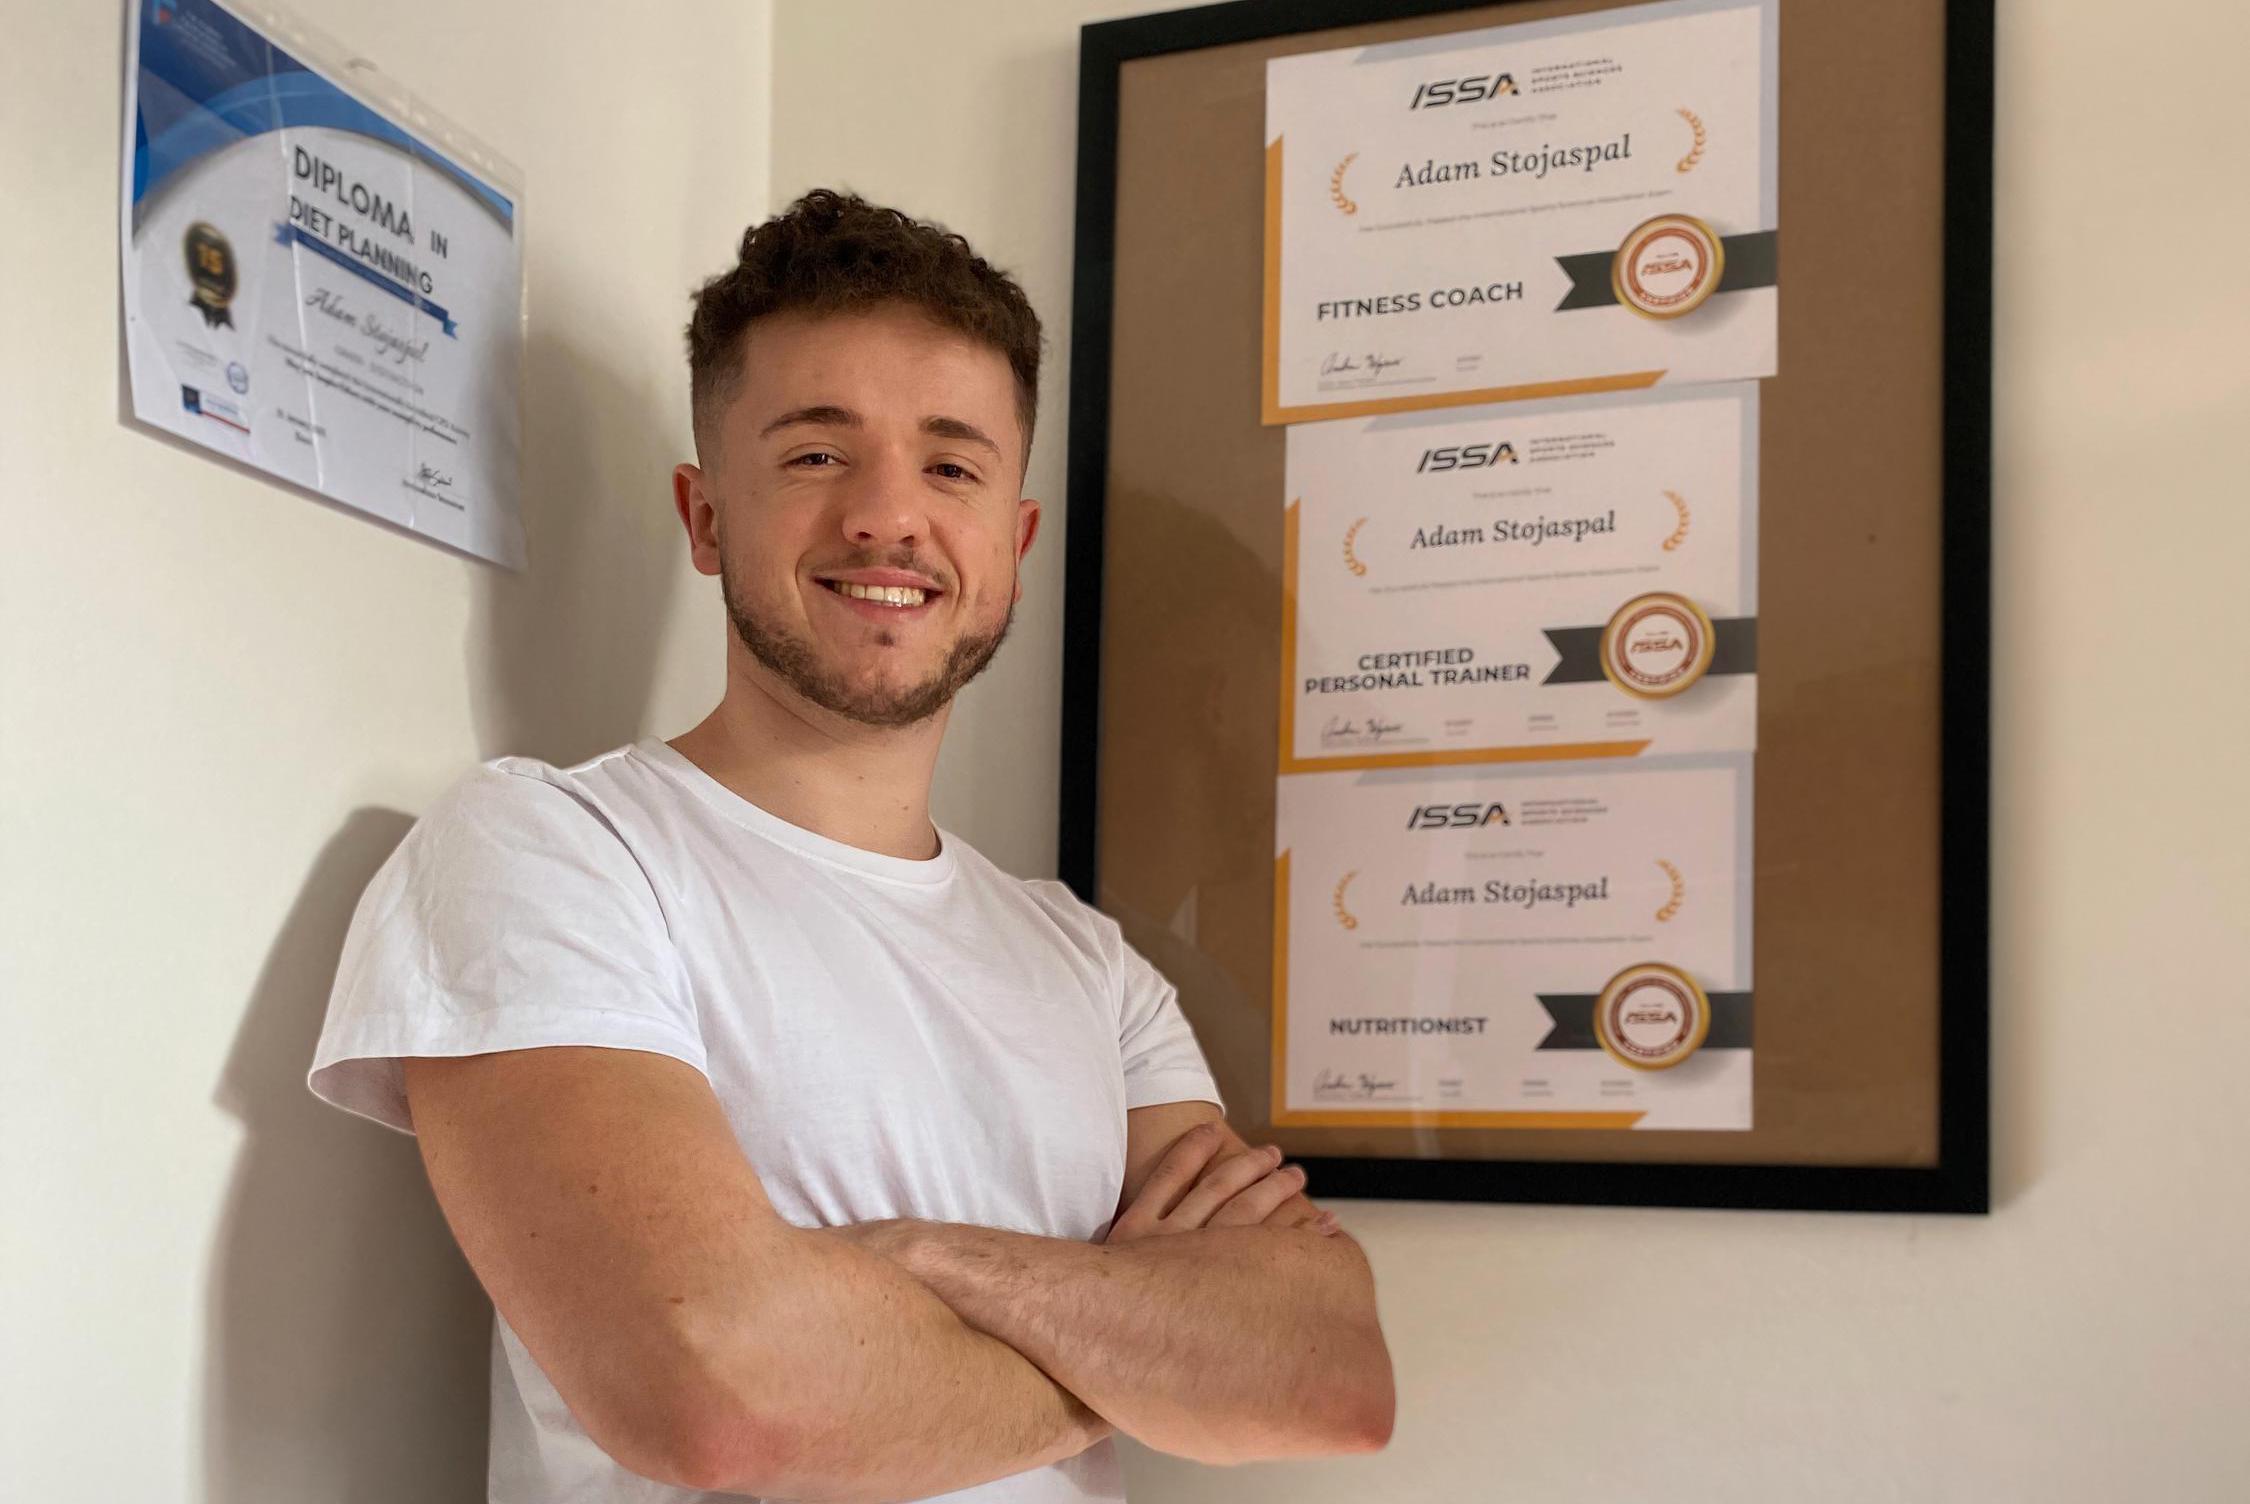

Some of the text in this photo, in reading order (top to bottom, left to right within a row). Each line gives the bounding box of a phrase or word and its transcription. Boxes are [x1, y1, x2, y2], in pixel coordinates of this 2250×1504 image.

[1409, 72, 1520, 111] ISSA
[1395, 133, 1632, 189] Adam Stojaspal
[295, 144, 448, 259] DIPLOMA IN
[290, 195, 433, 294] DIET PLANNING
[1317, 281, 1523, 321] FITNESS COACH
[1416, 440, 1519, 475] ISSA
[1410, 509, 1615, 550] Adam Stojaspal
[1358, 647, 1474, 671] CERTIFIED
[1305, 663, 1531, 694] PERSONAL TRAINER
[1407, 801, 1511, 830] ISSA
[1400, 876, 1607, 910] Adam Stojaspal
[1329, 1016, 1489, 1035] NUTRITIONIST
